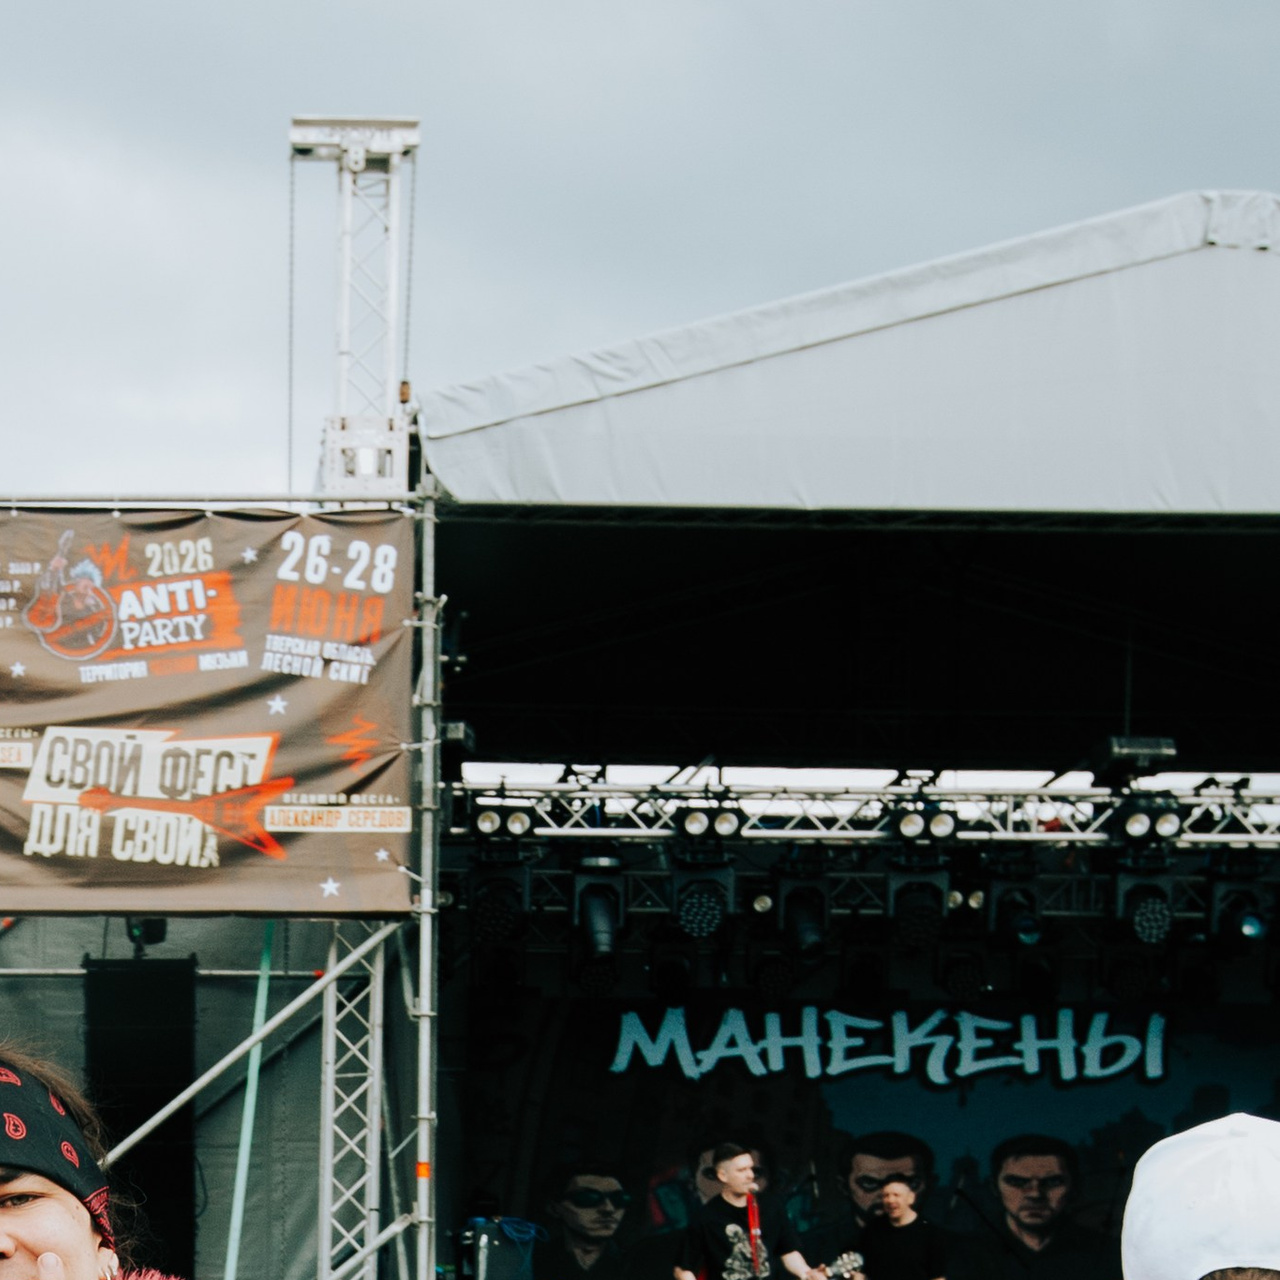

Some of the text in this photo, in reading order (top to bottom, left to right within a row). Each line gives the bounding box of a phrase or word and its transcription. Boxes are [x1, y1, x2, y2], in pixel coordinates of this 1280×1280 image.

[145, 536, 214, 578] 2026
[276, 530, 398, 595] 26-28
[118, 578, 217, 621] ANTI-
[269, 583, 386, 645] ИЮНЯ
[120, 613, 207, 650] PARTY
[261, 652, 324, 679] ЛЕСНОЙ
[44, 734, 258, 801] СВОЙ ФЕСТ
[23, 803, 101, 858] ДЛЯ
[609, 1005, 1166, 1085] МАНЕКЕНЫ
